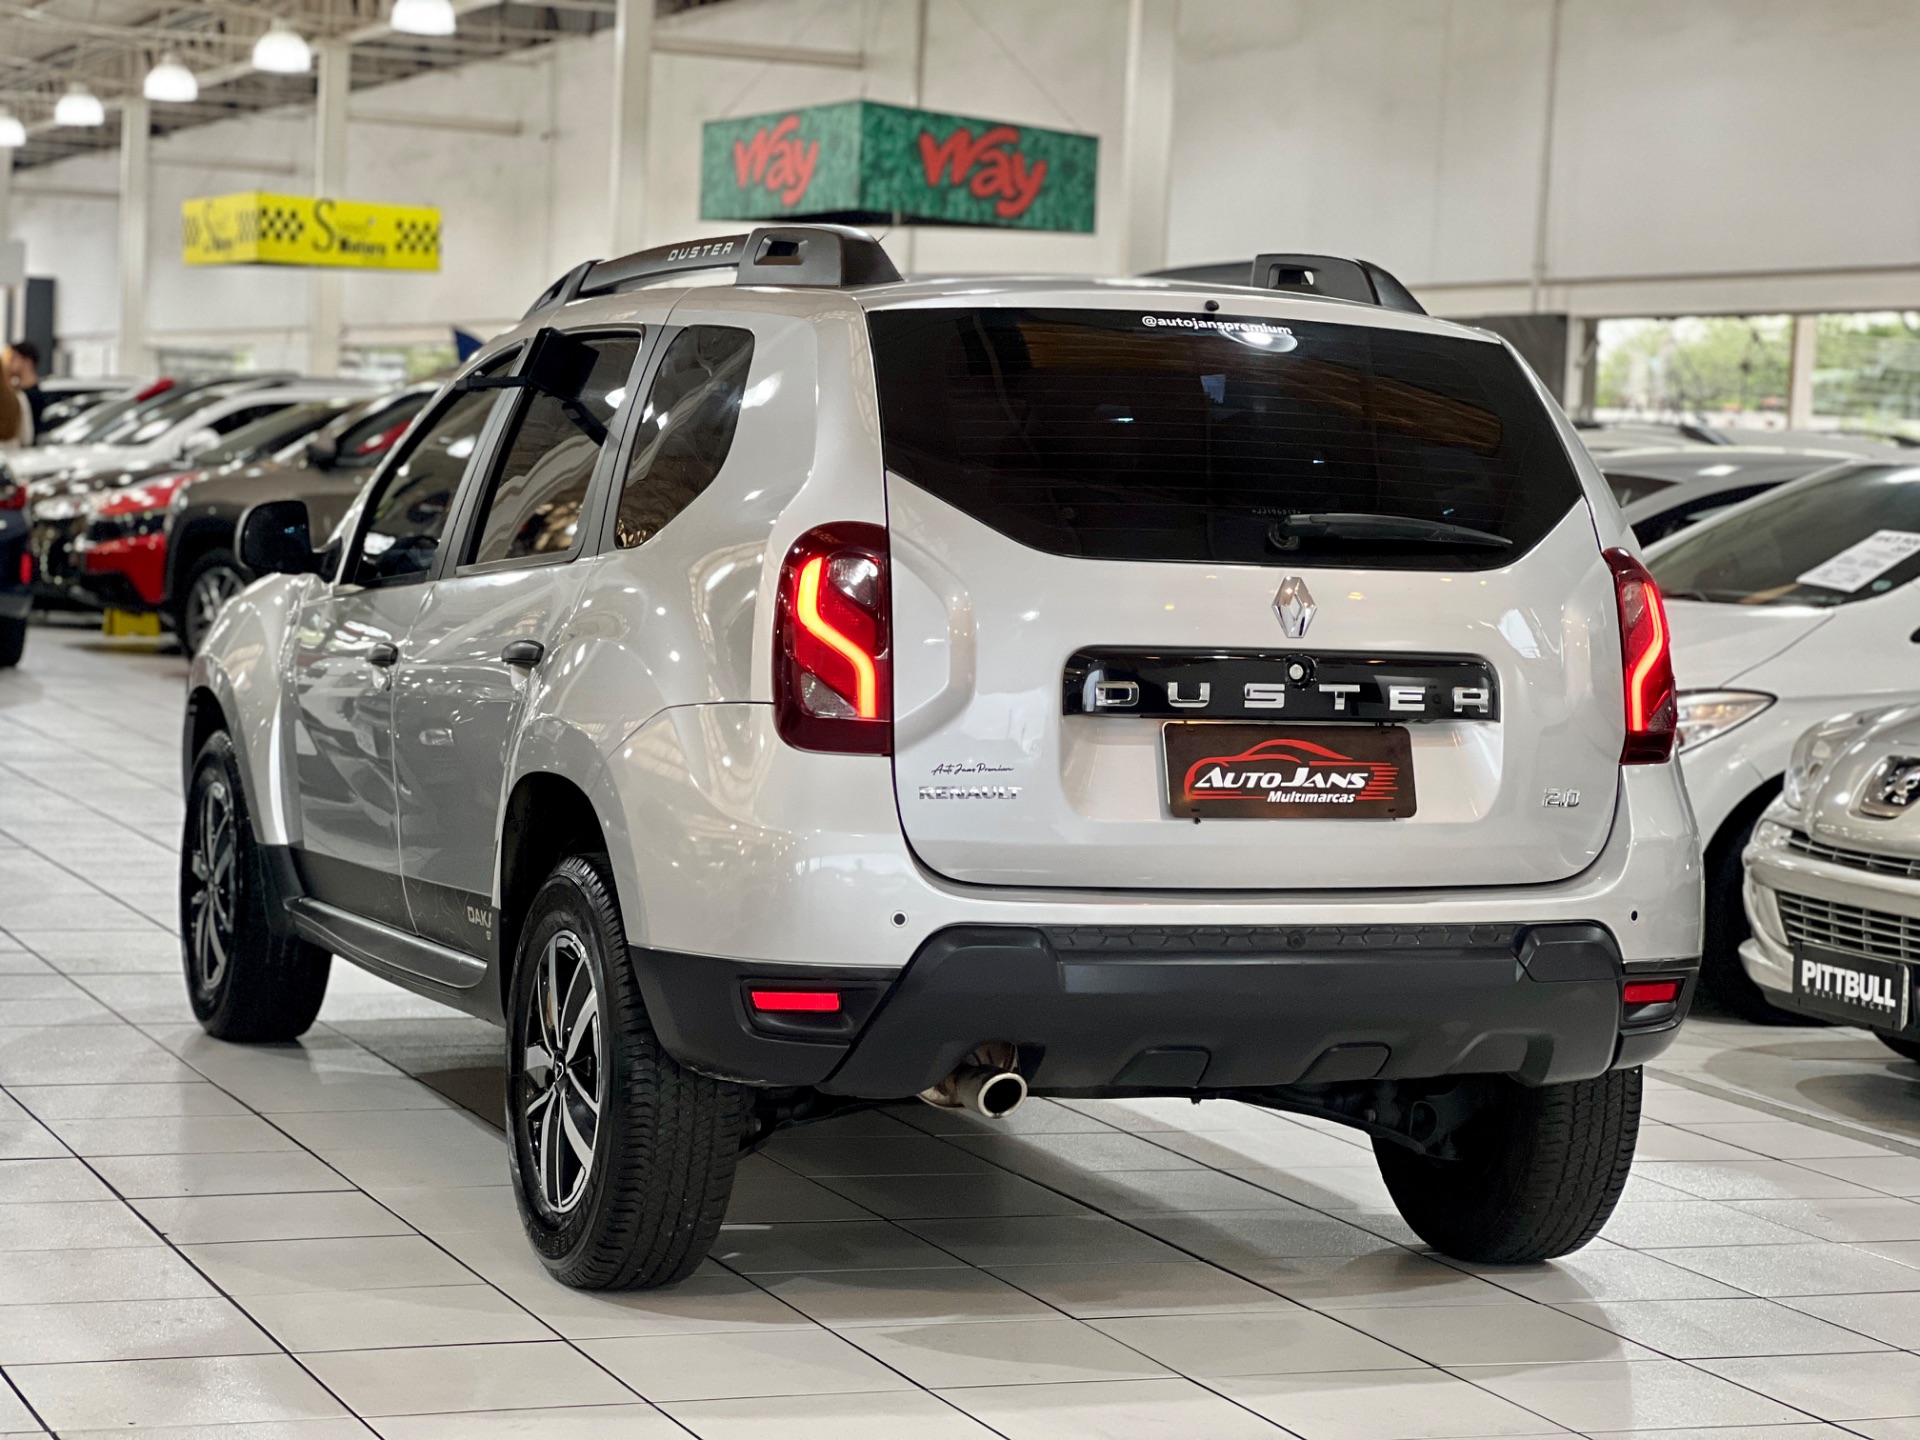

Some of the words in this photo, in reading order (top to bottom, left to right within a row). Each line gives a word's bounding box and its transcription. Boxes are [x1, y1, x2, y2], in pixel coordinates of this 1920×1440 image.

[733, 115, 820, 207] Way
[918, 126, 1048, 218] Way
[667, 241, 734, 262] DUSTER
[1141, 315, 1293, 335] @autojanspremium
[1095, 680, 1489, 713] DUSTER
[931, 763, 954, 776] Auto
[919, 785, 1023, 800] RENAULT
[1267, 790, 1356, 804] Multimarcas
[1542, 788, 1580, 808] 2.0
[1801, 959, 1896, 1008] PITTBULL
[1804, 986, 1891, 1014] MULTIMARCAS
